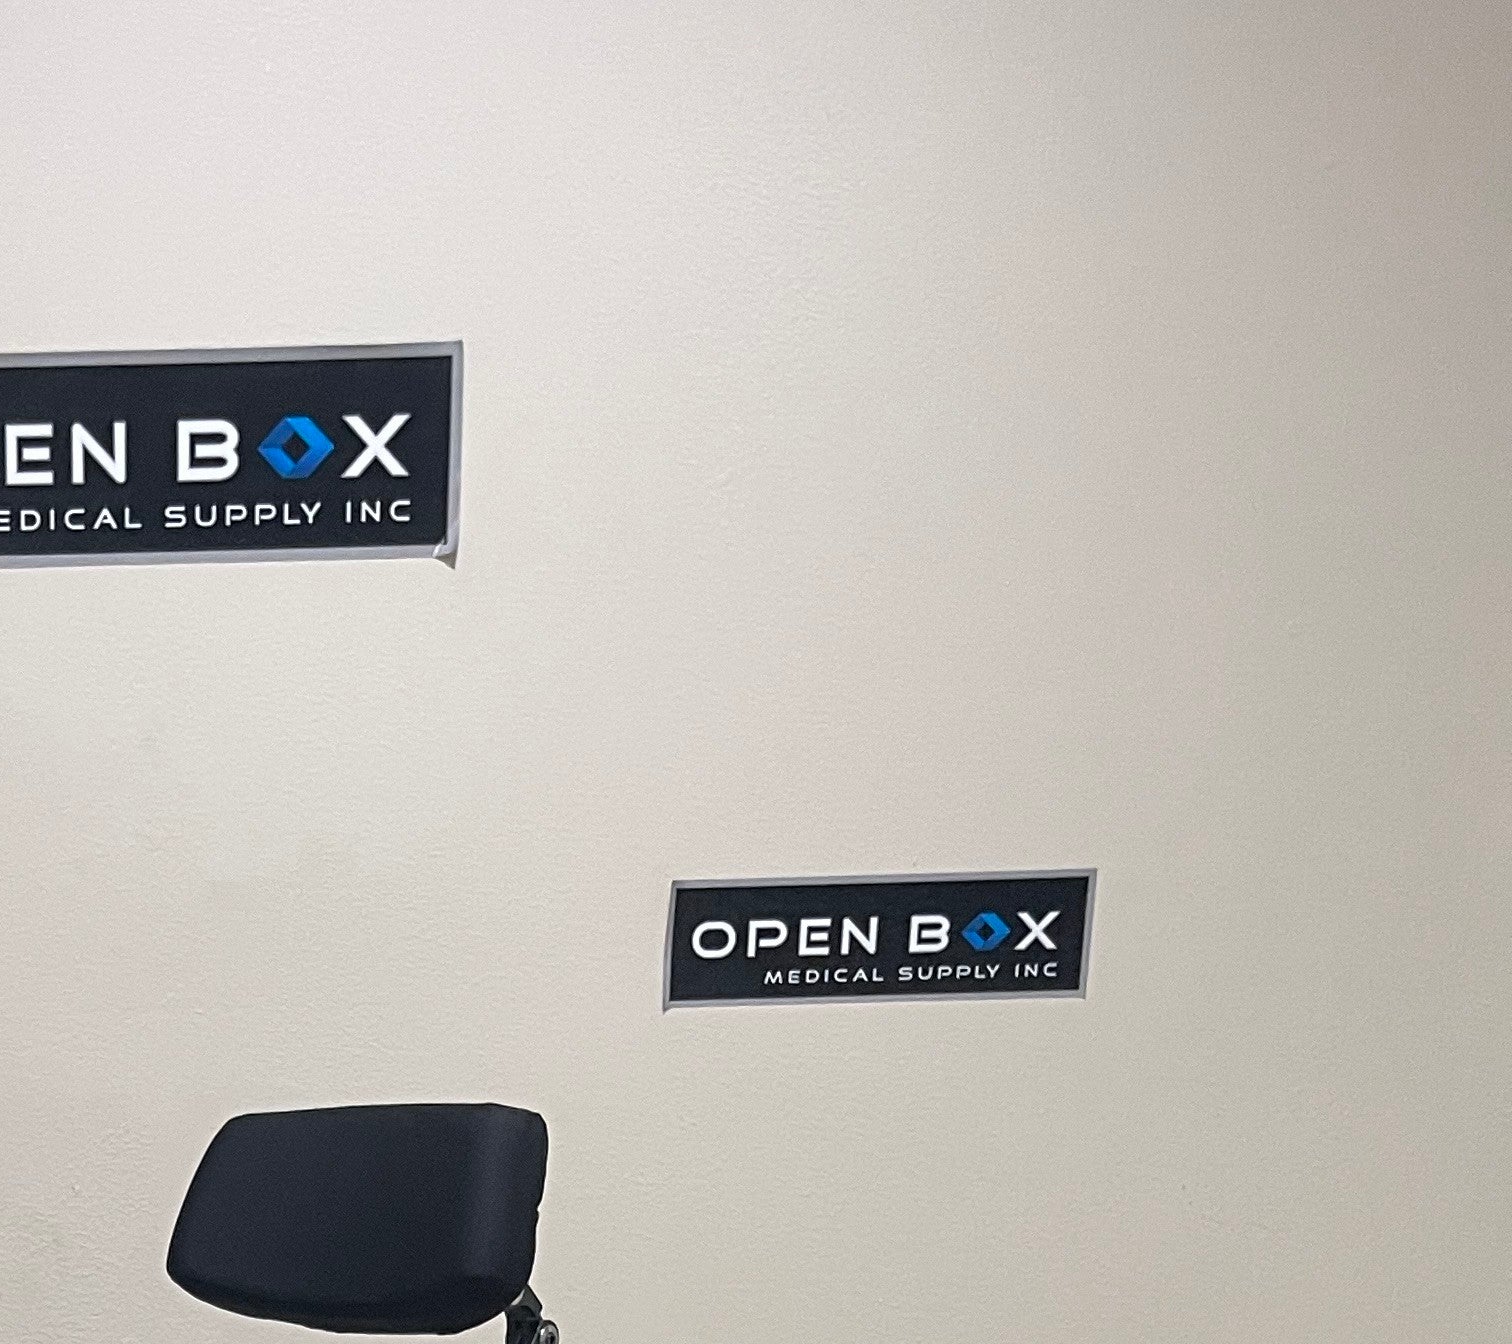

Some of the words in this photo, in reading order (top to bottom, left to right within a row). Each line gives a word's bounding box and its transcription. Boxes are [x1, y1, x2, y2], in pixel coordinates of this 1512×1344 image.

[165, 502, 321, 527] SUPPLY
[346, 500, 410, 522] INC
[692, 917, 878, 958] OPEN
[764, 968, 883, 984] MEDICAL
[899, 965, 999, 980] SUPPLY
[1015, 963, 1057, 977] INC
